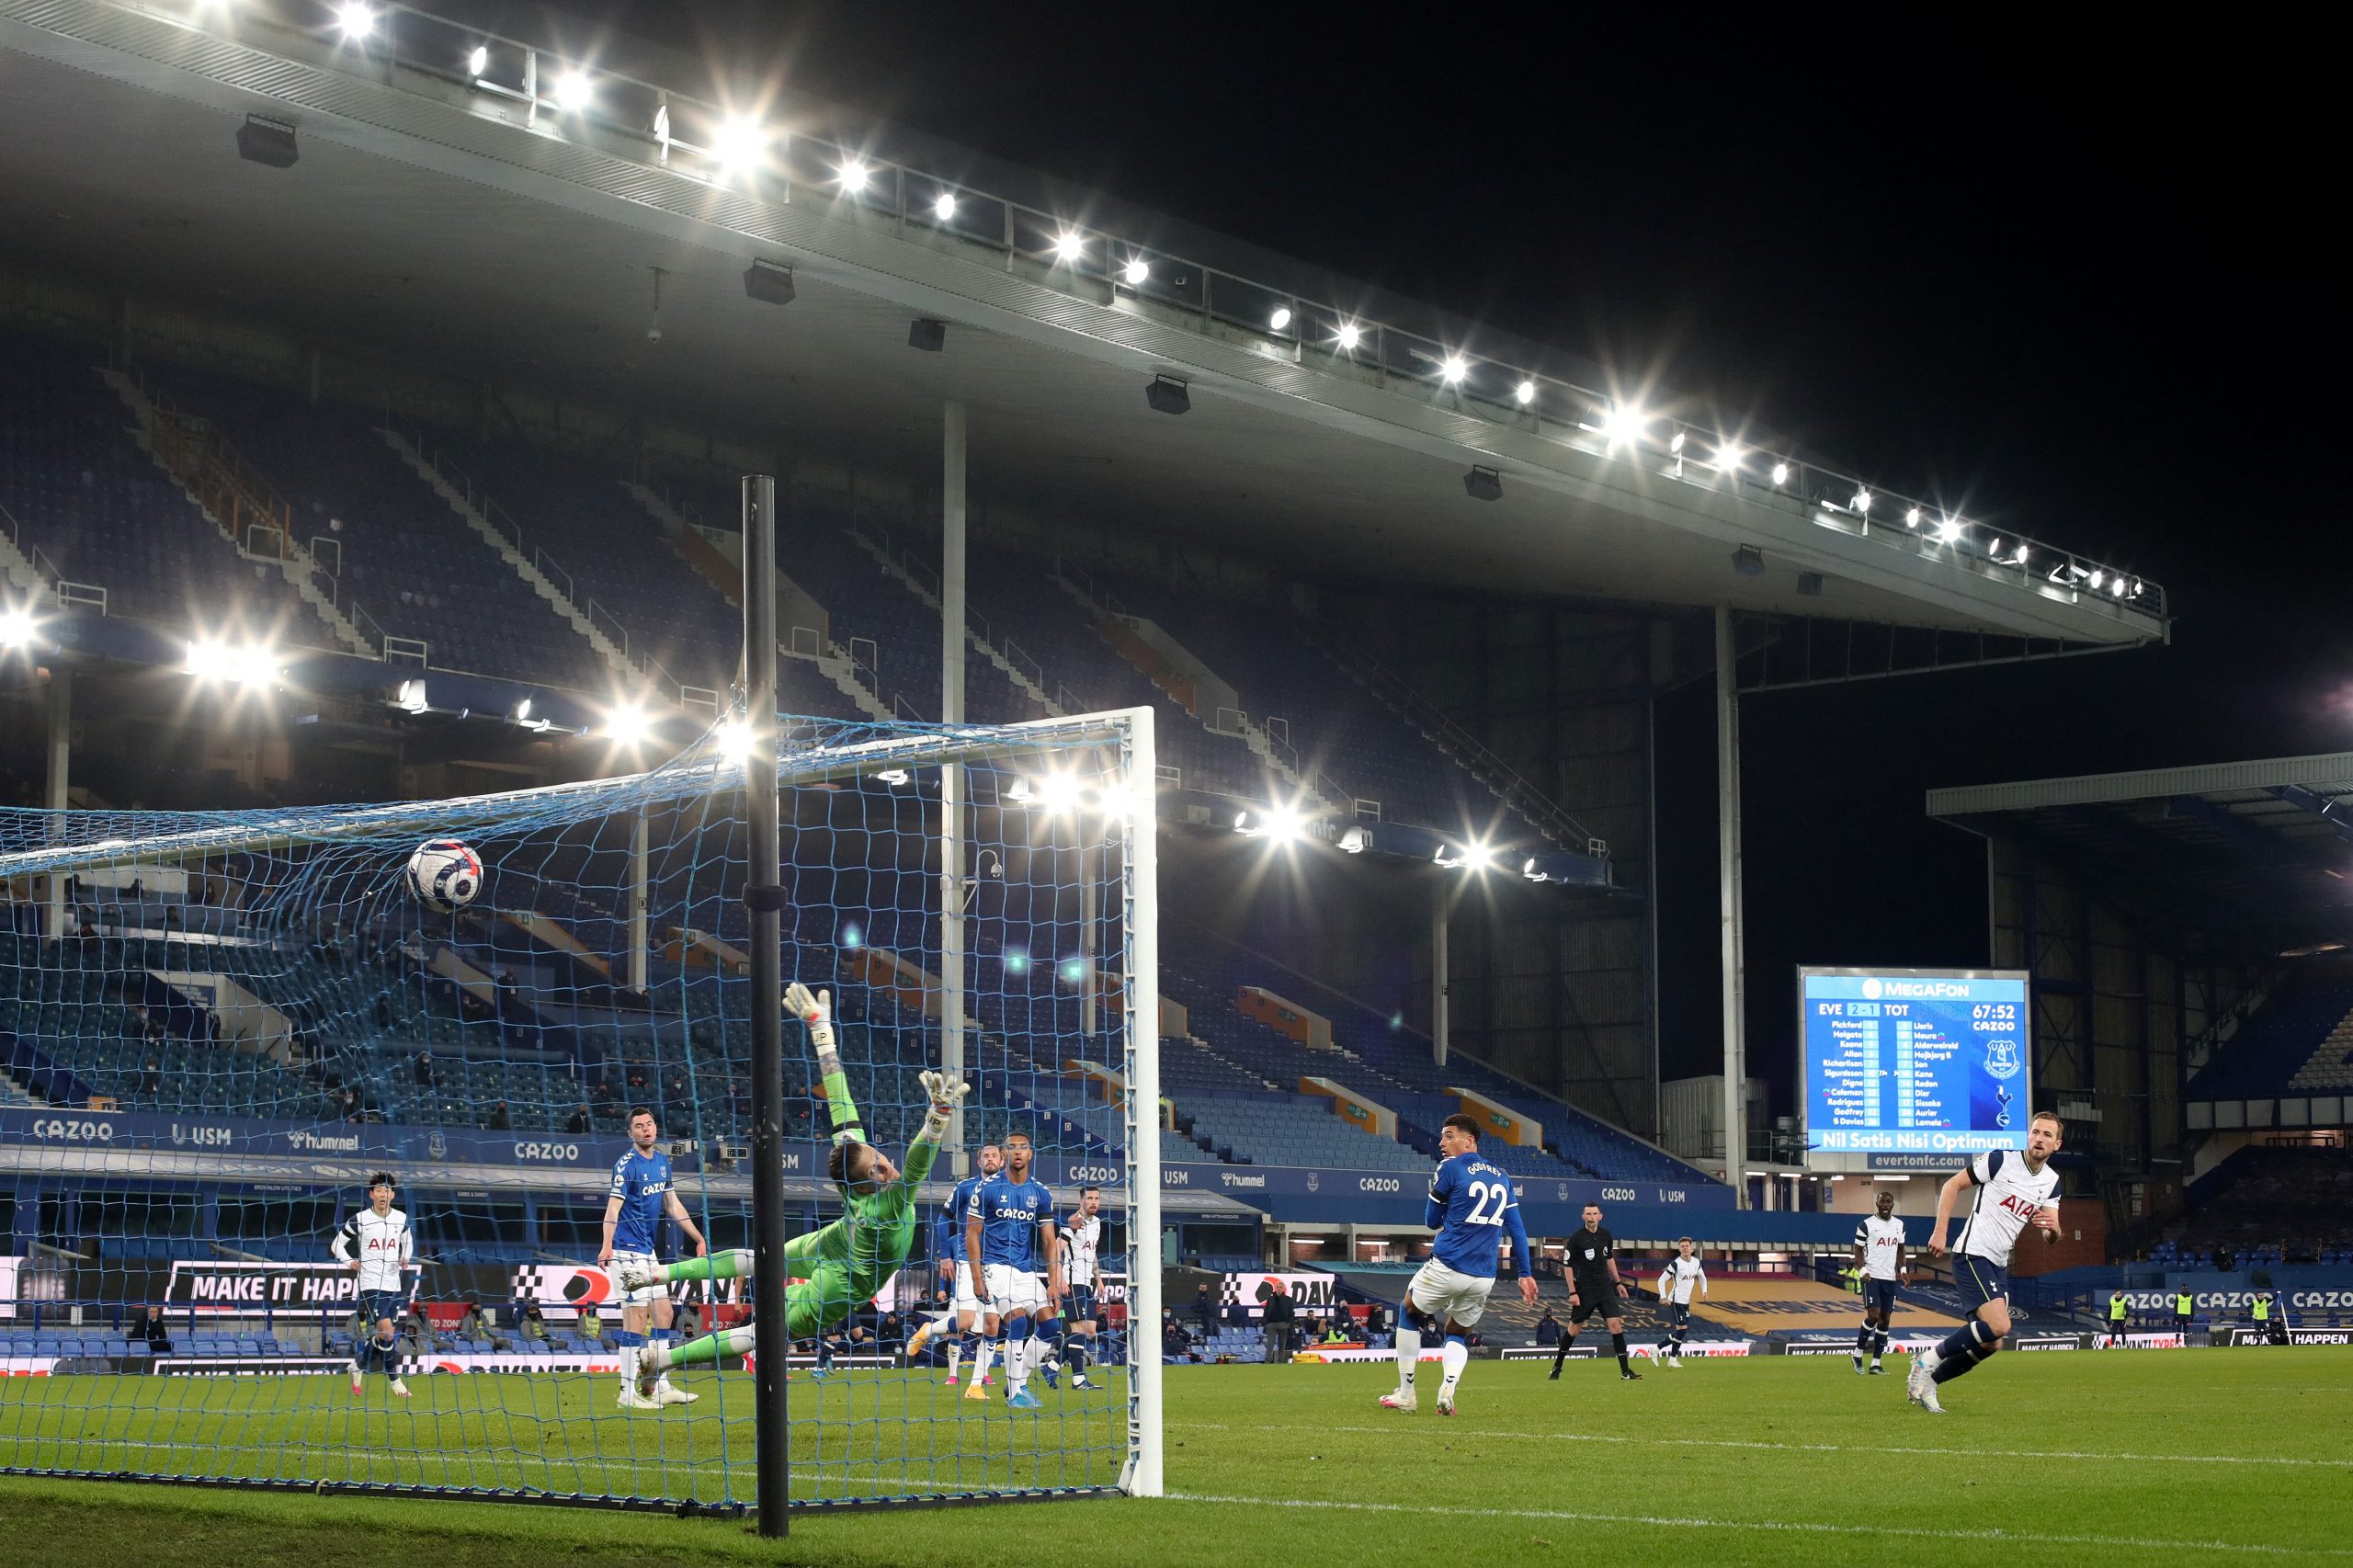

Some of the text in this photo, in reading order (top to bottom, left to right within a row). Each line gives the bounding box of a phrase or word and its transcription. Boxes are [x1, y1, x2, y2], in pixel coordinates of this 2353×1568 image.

[1885, 983, 1970, 997] MEGAFON
[1819, 1004, 1842, 1015] EVE
[1884, 1005, 1909, 1016] TOT
[1972, 1005, 2015, 1019] 67:52
[1972, 1021, 2015, 1031] CAZOO
[1833, 1031, 1863, 1040] Holgate
[1842, 1079, 1863, 1087] Digne
[1831, 1088, 1863, 1096] Coleman
[1834, 1108, 1863, 1117] Godfrey
[34, 1119, 113, 1141] CAZOO
[192, 1127, 232, 1145] USM
[306, 1132, 358, 1151] hummel
[1823, 1132, 2014, 1153] Nil Satis Nisi Optimum
[515, 1142, 579, 1160] CAZOO
[1875, 1154, 1965, 1166] evertonfc.com
[1069, 1165, 1118, 1182] CAZOO
[1468, 1162, 1502, 1177] GODFREY
[1165, 1170, 1188, 1185] USM
[1233, 1173, 1266, 1187] hummel
[1359, 1177, 1400, 1191] CAZOO
[1602, 1187, 1635, 1201] CAZOO
[1668, 1190, 1686, 1202] USM
[1464, 1181, 1507, 1227] 22
[1999, 1194, 2036, 1220] AIA
[995, 1209, 1035, 1221] CAZOO
[368, 1237, 397, 1251] AIA
[1877, 1237, 1898, 1247] AIA
[192, 1276, 266, 1301] MAKE
[271, 1277, 296, 1301] IT
[2295, 1335, 2349, 1345] HAPPEN
